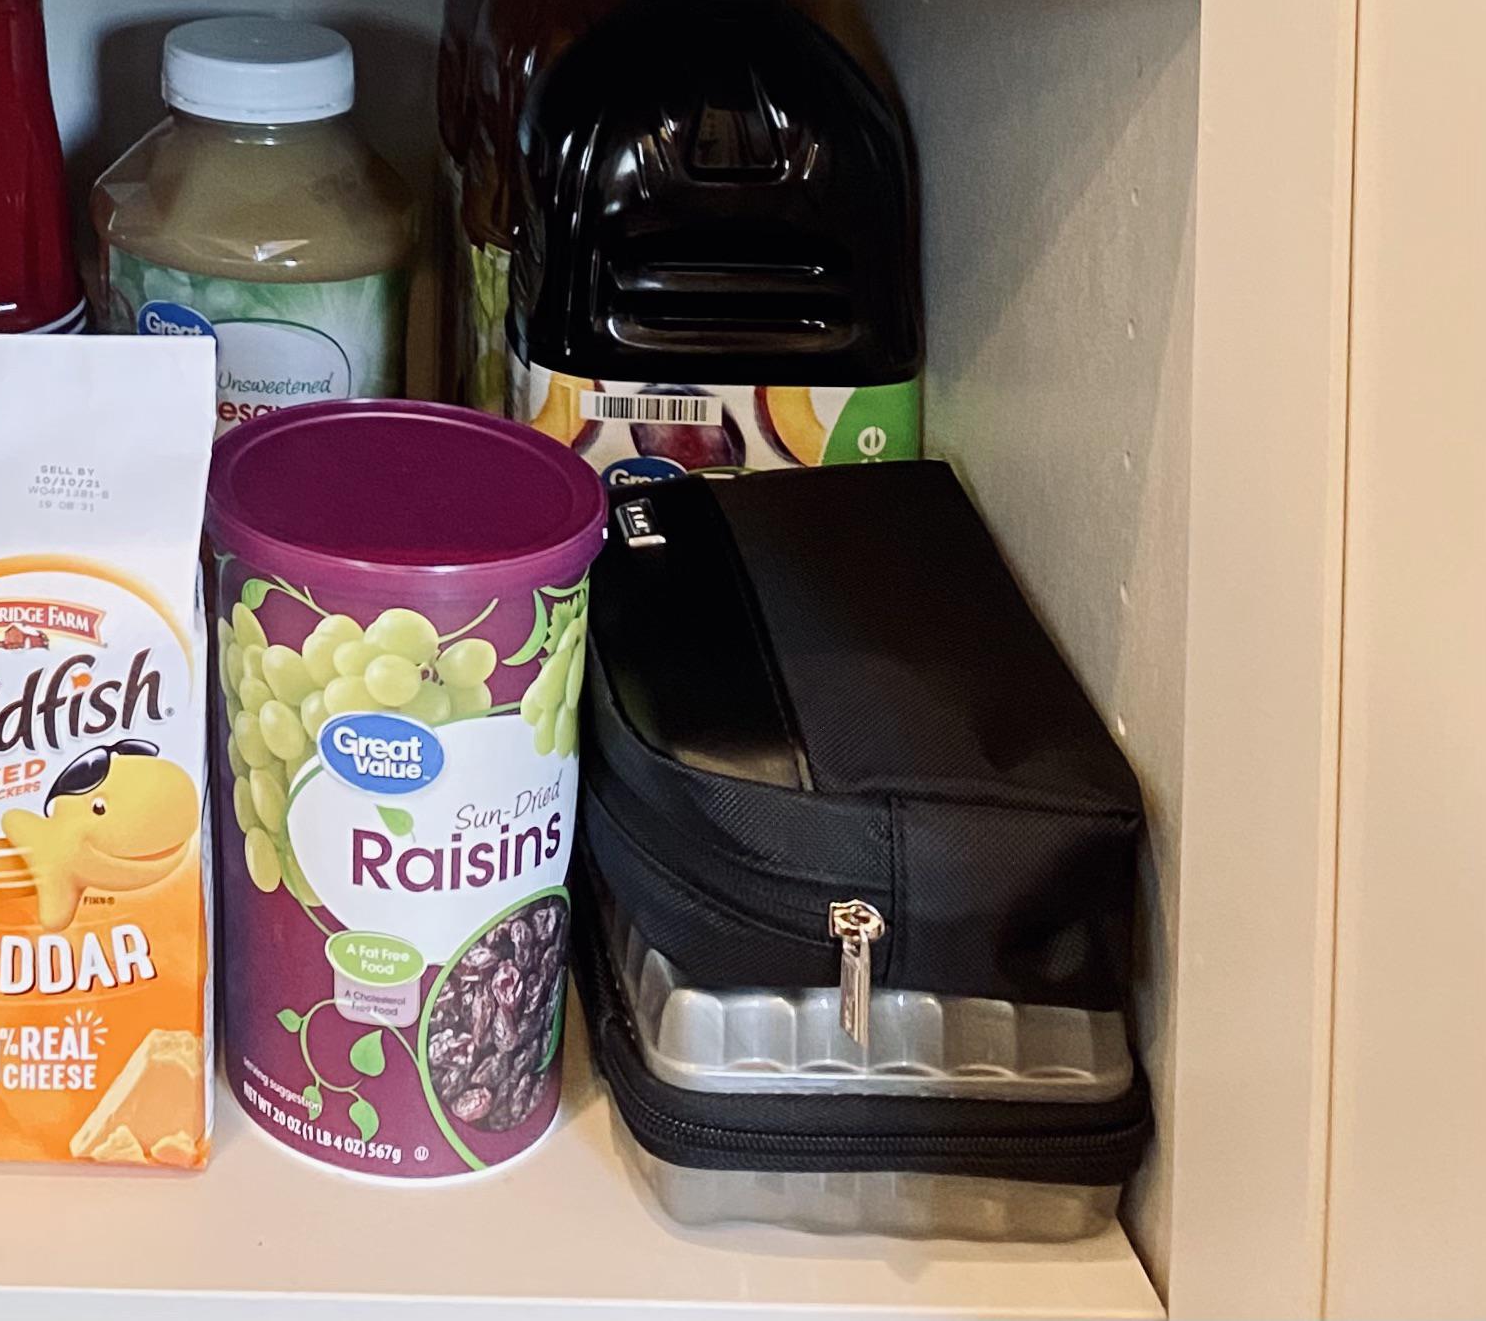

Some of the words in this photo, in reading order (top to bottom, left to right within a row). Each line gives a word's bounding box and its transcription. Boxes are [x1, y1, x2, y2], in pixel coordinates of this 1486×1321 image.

[217, 371, 334, 395] Unsweetened
[35, 476, 100, 488] 10/10/21
[40, 465, 73, 475] SELL
[48, 606, 90, 632] FARM
[333, 726, 423, 761] Great
[353, 753, 423, 780] Value
[455, 769, 562, 831] Sun-Dried
[352, 811, 562, 893] Raisins
[359, 945, 378, 958] Fat
[381, 949, 410, 962] Free
[361, 960, 395, 976] Food
[21, 1025, 98, 1061] REAL
[3, 1064, 97, 1090] CHEESE
[270, 1079, 323, 1112] suggestion
[244, 1080, 257, 1105] NET
[257, 1096, 272, 1117] WT
[273, 1106, 286, 1126] 20
[287, 1115, 302, 1135] OZ
[302, 1123, 314, 1141] (1
[316, 1129, 332, 1147] LB
[333, 1138, 343, 1150] 4
[344, 1139, 366, 1158] OZ)
[368, 1143, 402, 1164] 567g
